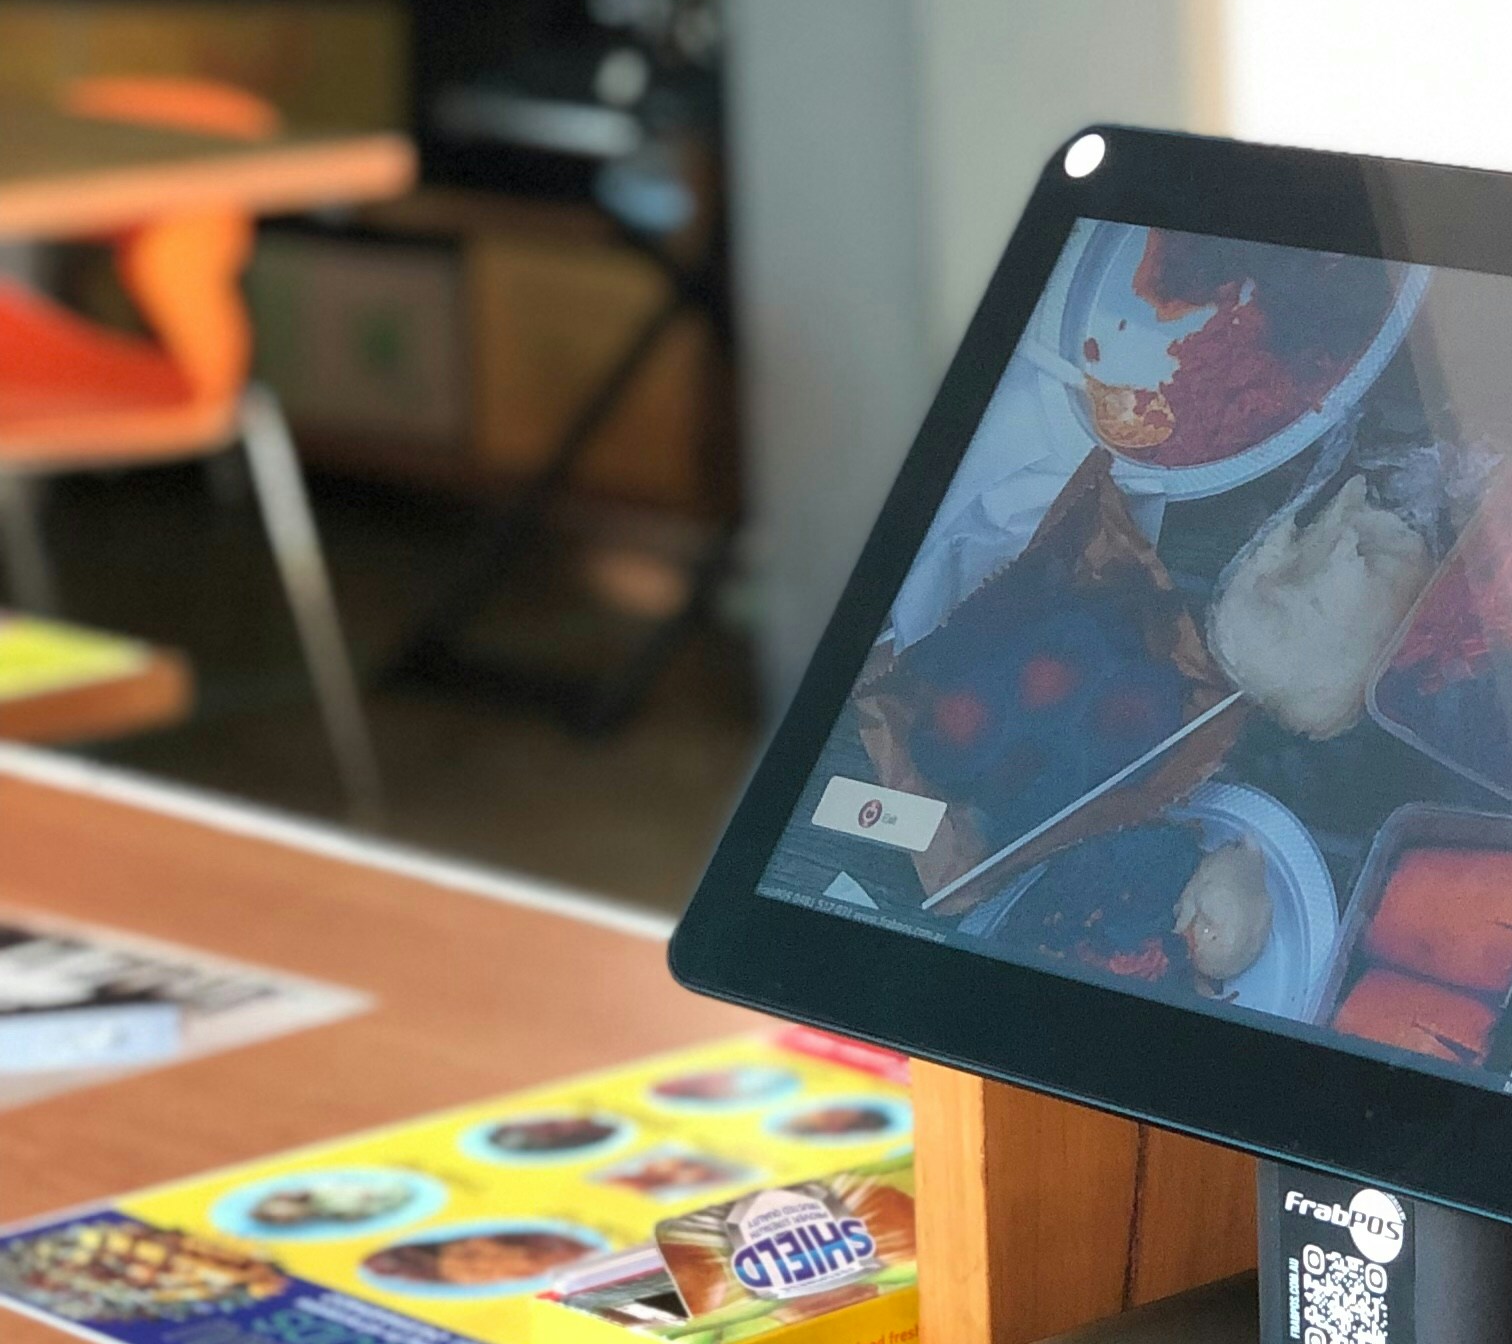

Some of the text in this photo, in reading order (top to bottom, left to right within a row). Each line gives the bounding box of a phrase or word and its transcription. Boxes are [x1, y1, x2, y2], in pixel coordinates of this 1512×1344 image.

[1285, 1190, 1404, 1240] FrabPOS
[734, 1219, 874, 1288] SHIELD
[1289, 1258, 1300, 1339] FRABPOS.COM.AU
